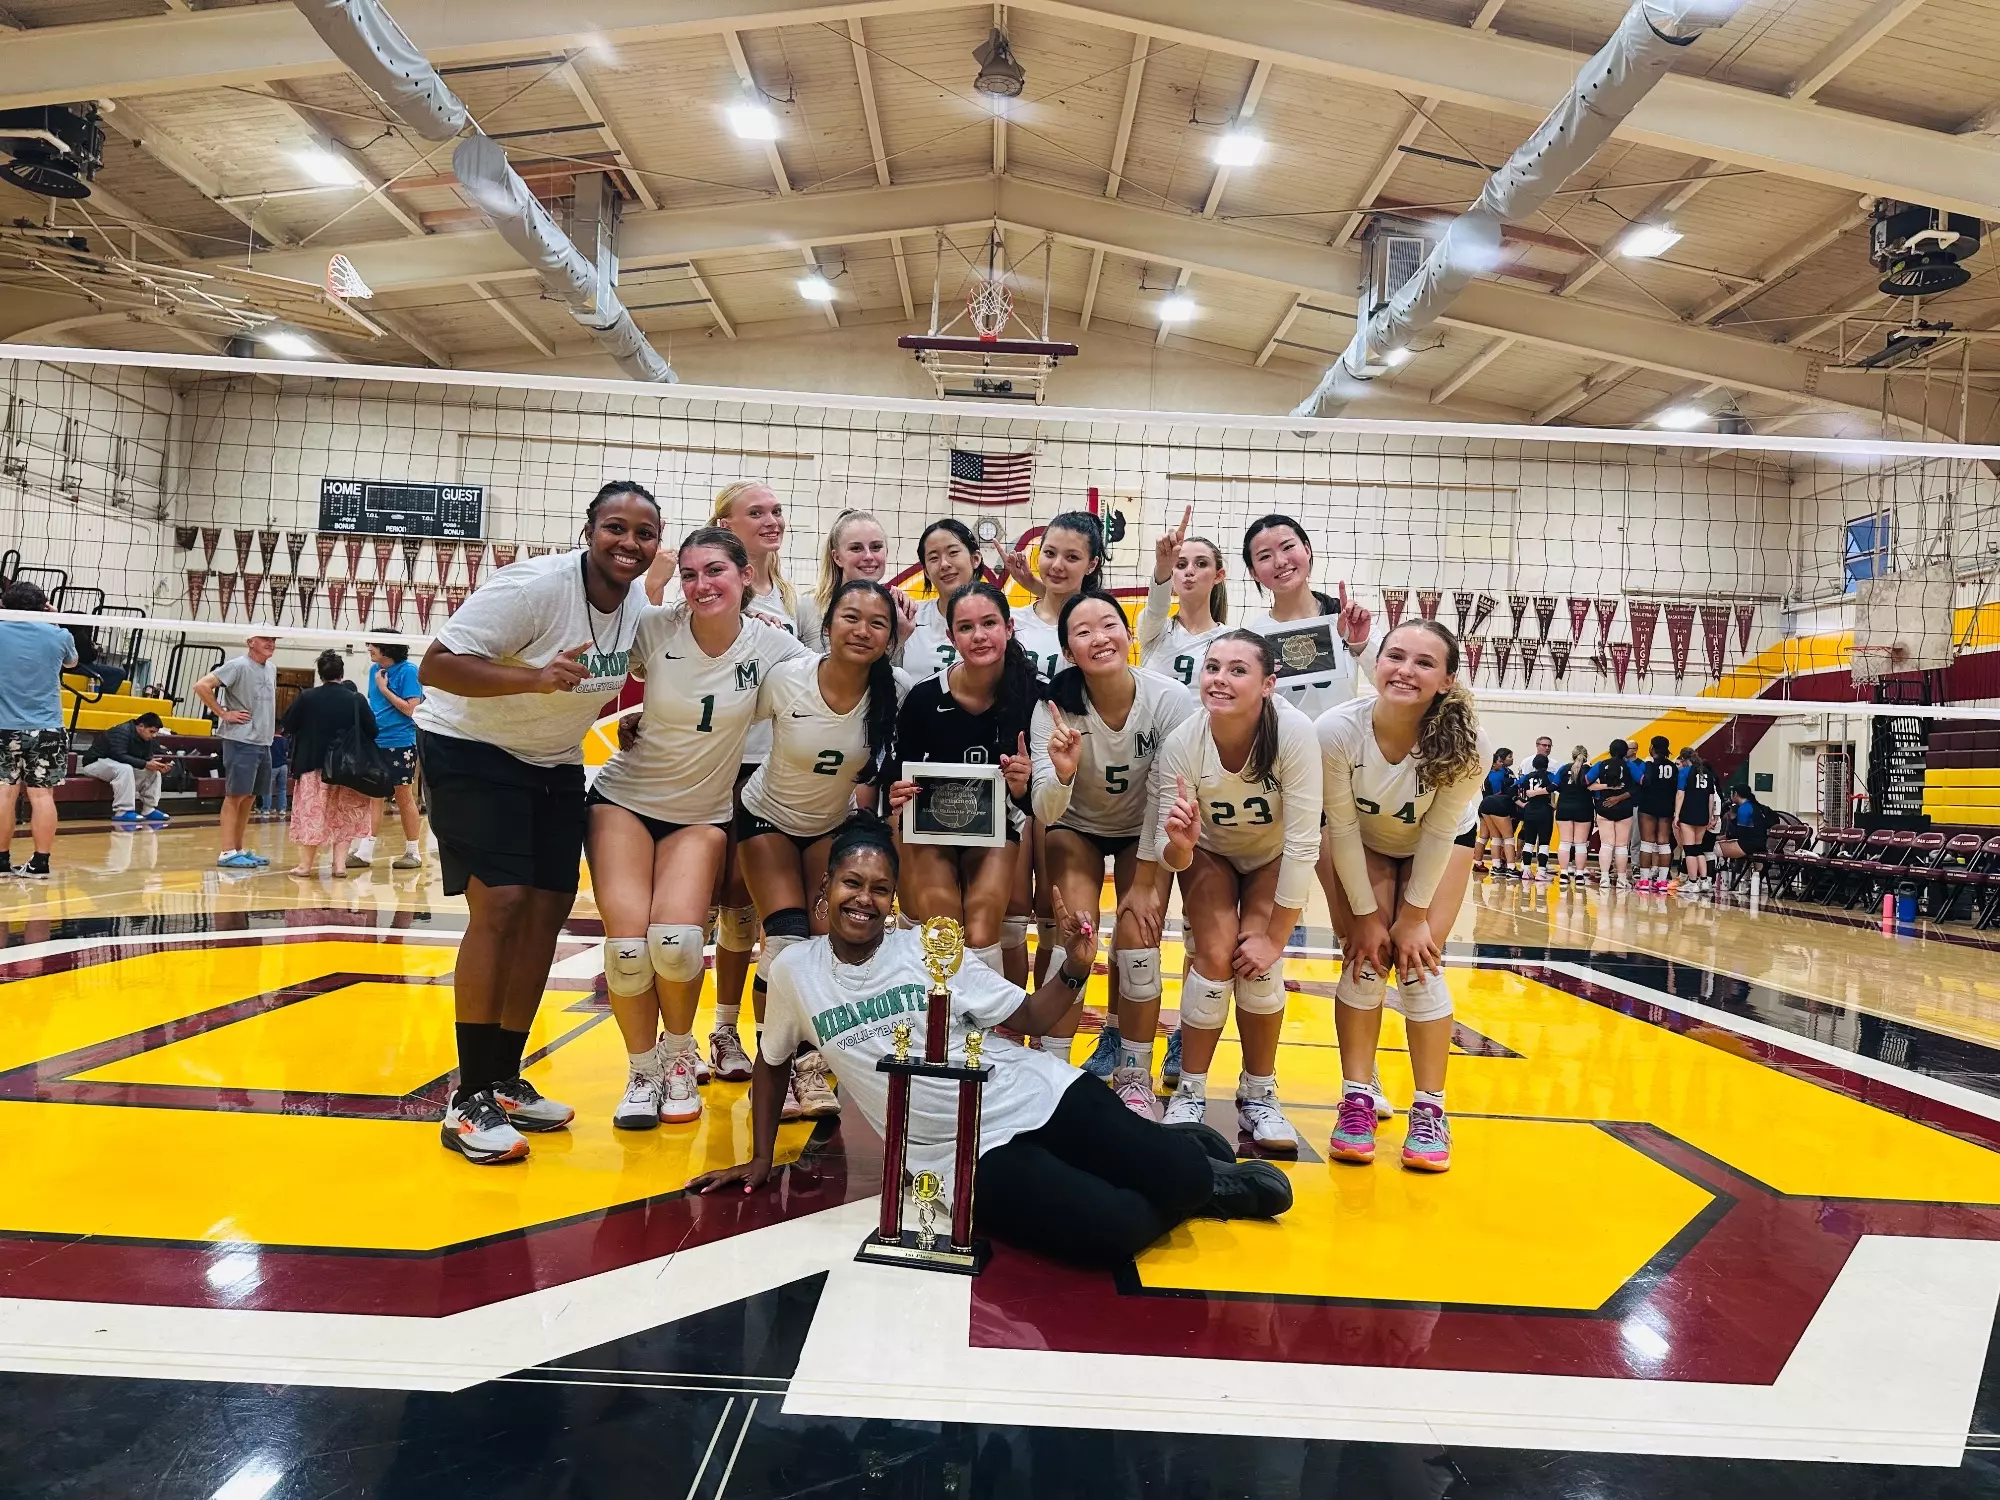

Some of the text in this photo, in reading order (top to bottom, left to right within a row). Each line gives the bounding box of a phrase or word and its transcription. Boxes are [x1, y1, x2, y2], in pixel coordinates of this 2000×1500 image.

[323, 482, 362, 496] HOME
[442, 488, 480, 502] GUEST
[934, 644, 957, 673] 3
[1173, 655, 1195, 685] 9
[735, 659, 760, 691] M
[696, 695, 715, 732] 1
[1135, 727, 1158, 758] M
[813, 750, 844, 775] 2
[1658, 765, 1673, 779] 10
[1105, 764, 1130, 794] 5
[1695, 774, 1708, 789] 15
[1210, 797, 1273, 826] 23
[811, 983, 928, 1047] MIRAMONTE
[836, 1018, 916, 1050] VOLLEYBALL
